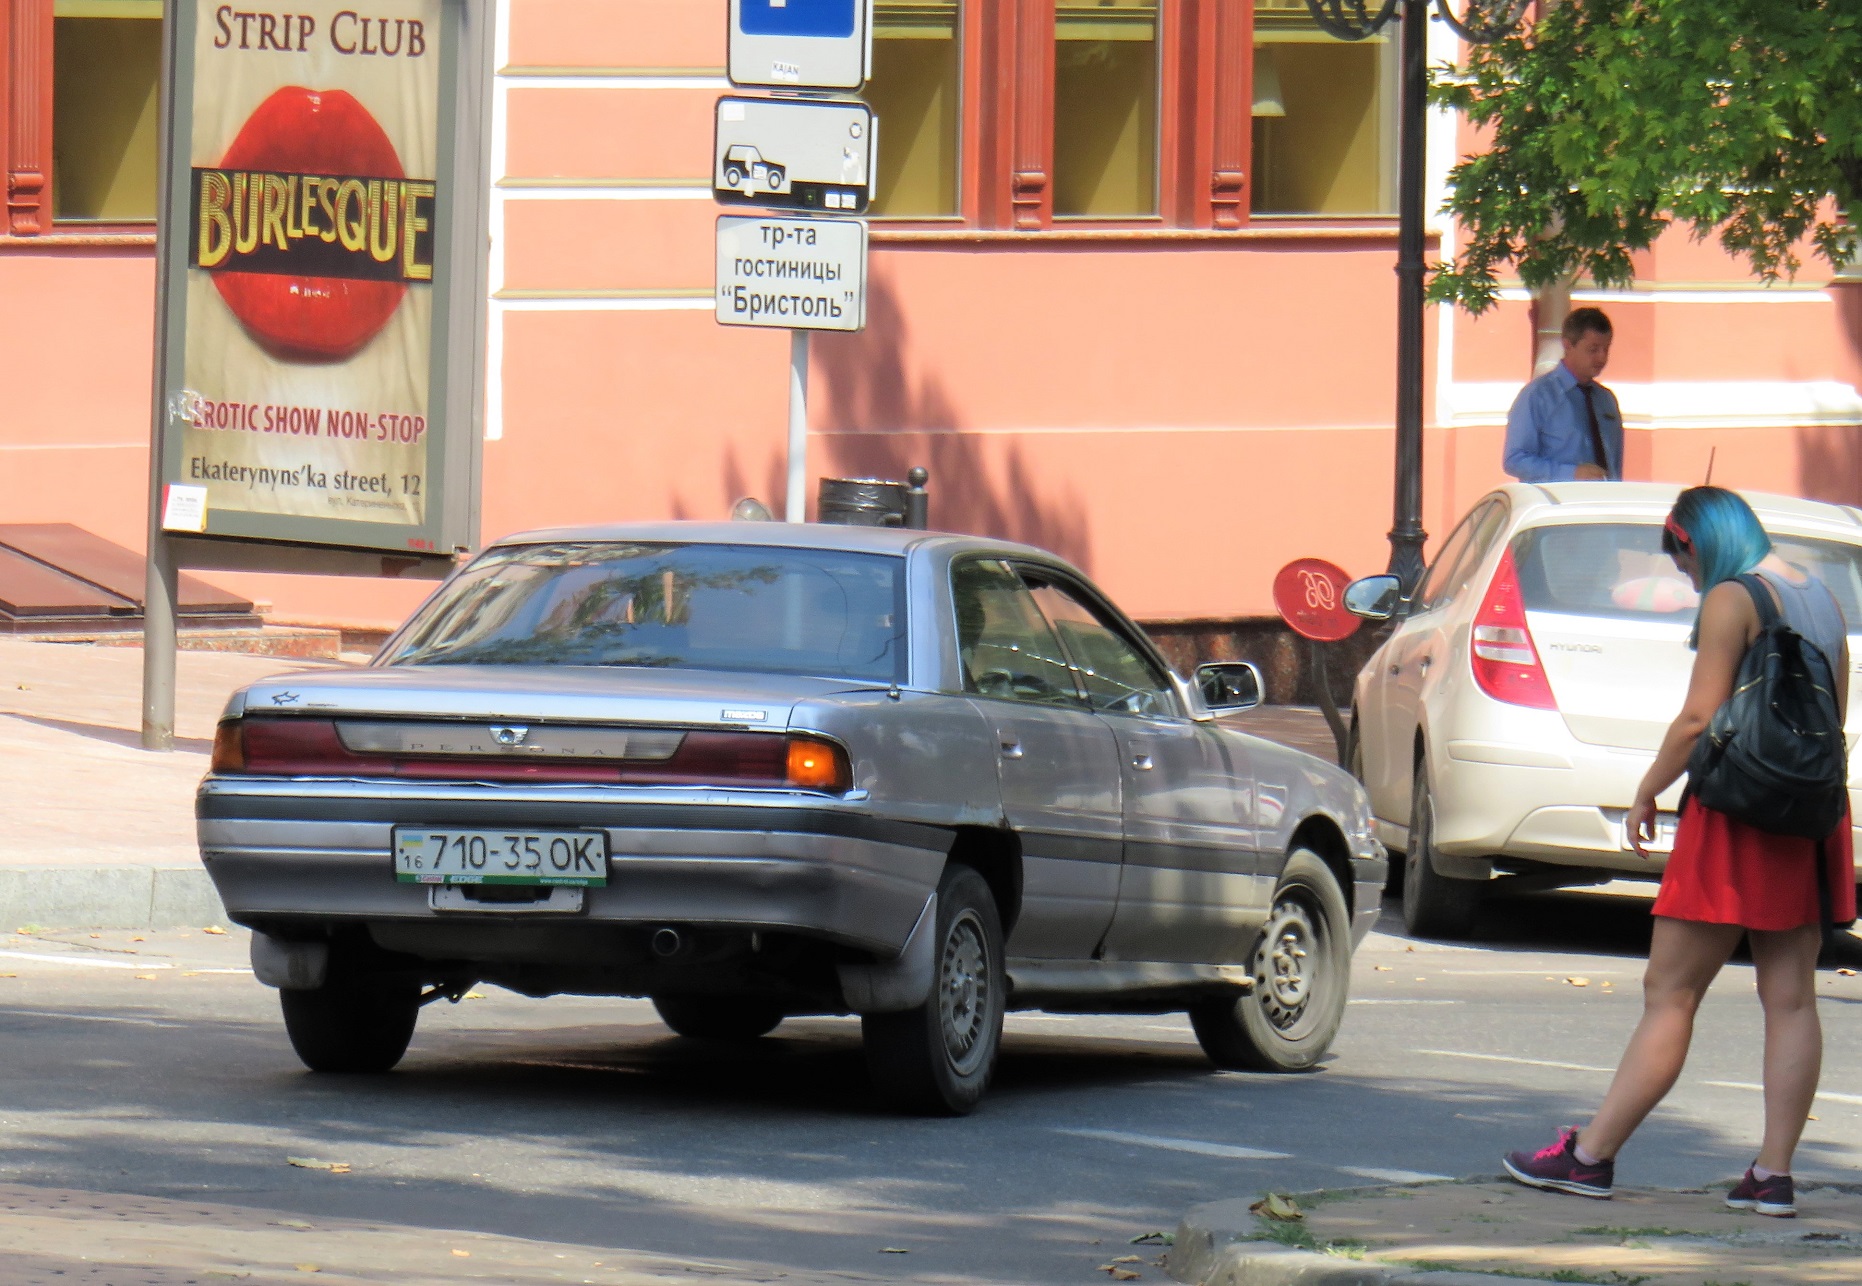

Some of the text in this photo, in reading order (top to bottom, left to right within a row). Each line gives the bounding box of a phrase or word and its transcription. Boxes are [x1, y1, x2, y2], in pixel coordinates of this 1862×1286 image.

[198, 172, 436, 280] BURLESQUE
[760, 226, 817, 249] тр-та
[735, 258, 841, 284] гостиницы
[264, 406, 321, 437] SHOW
[327, 410, 425, 443] NON-STOP
[334, 470, 392, 497] street,
[401, 475, 421, 496] 12
[411, 743, 604, 755] PERSONA
[404, 855, 423, 869] 16
[429, 834, 542, 870] 710-35
